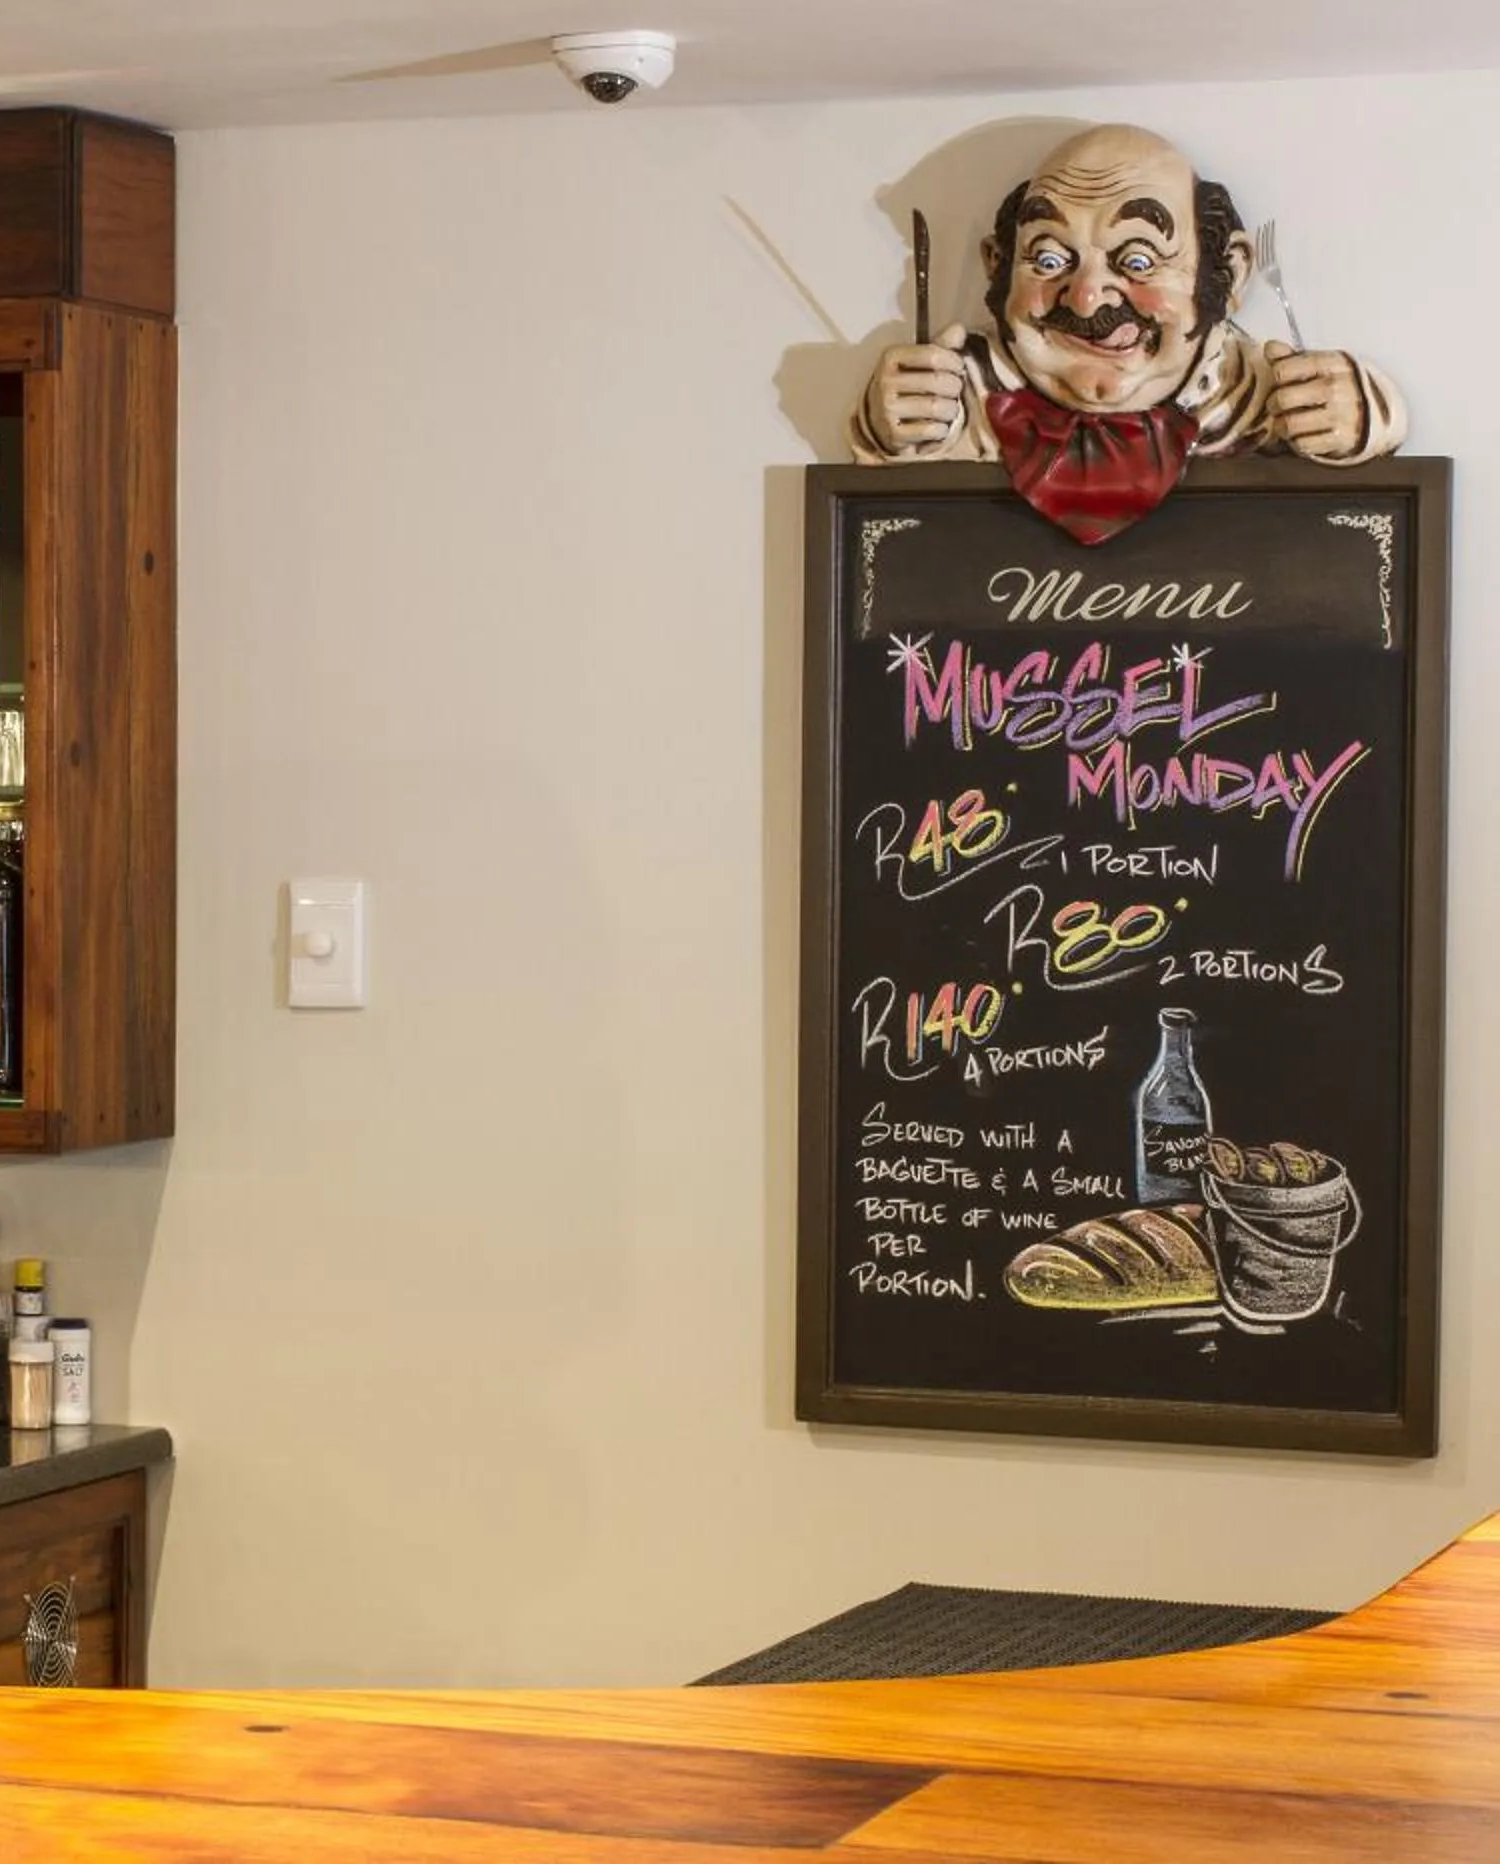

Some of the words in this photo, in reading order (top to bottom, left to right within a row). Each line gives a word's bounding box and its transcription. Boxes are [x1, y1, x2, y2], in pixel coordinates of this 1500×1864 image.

[988, 567, 1252, 622] Menu
[1080, 844, 1219, 886] PORTION
[1158, 956, 1186, 986] 2
[1189, 944, 1346, 995] PORTIONS
[963, 1054, 982, 1087] 4
[987, 1025, 1111, 1075] PORTIONS
[861, 1101, 964, 1147] SERVED
[980, 1122, 1035, 1149] WITH
[1056, 1129, 1073, 1152] A
[855, 1156, 981, 1189] BAGUETTE
[1023, 1168, 1039, 1192] A
[1051, 1166, 1125, 1198] SMALL
[854, 1197, 947, 1224] BOTTLE
[962, 1208, 992, 1227] OF
[1000, 1212, 1058, 1229] WINE
[867, 1232, 927, 1258] PER
[849, 1258, 987, 1300] PORTION.
